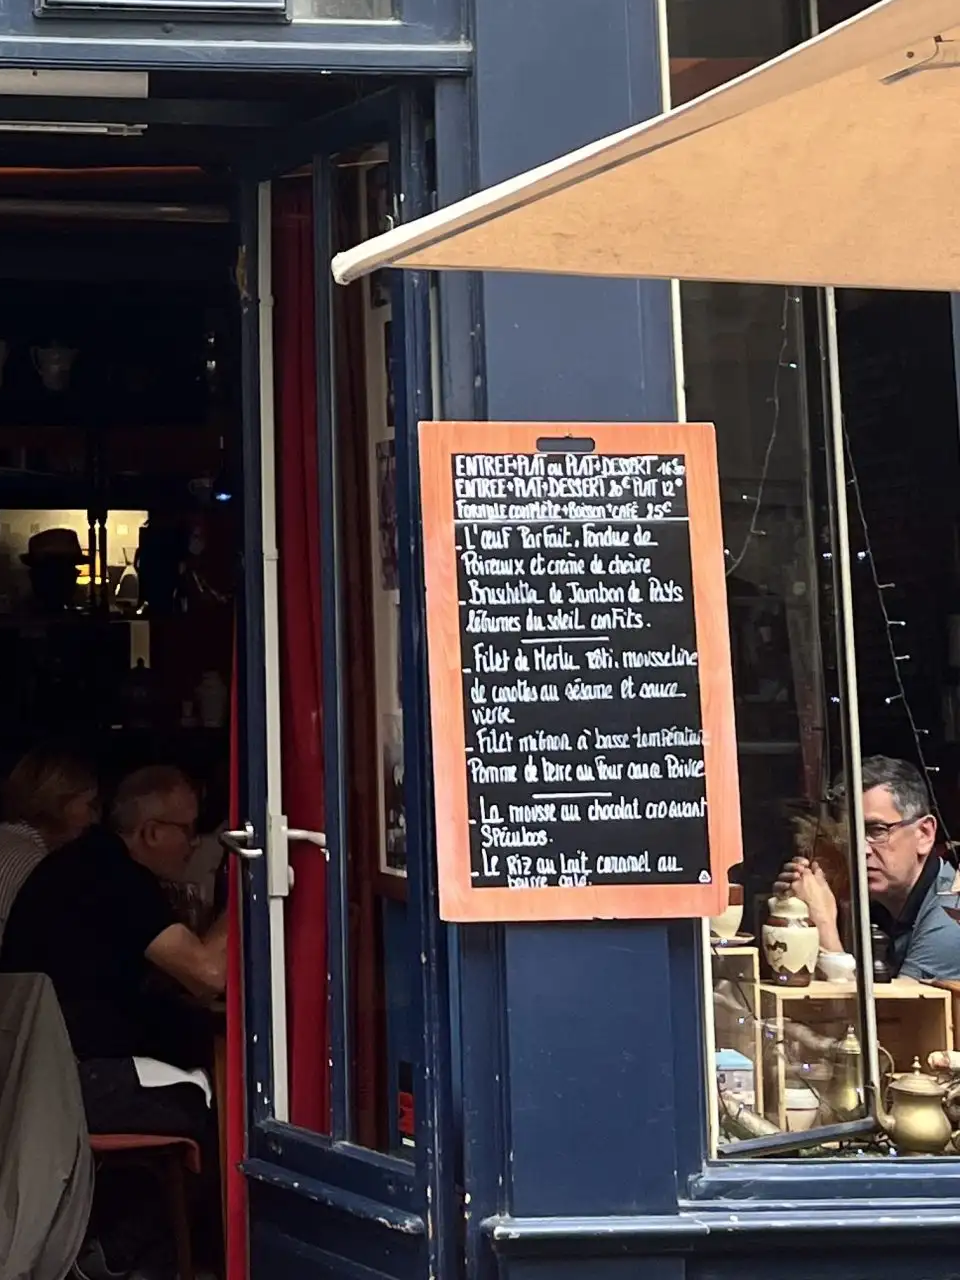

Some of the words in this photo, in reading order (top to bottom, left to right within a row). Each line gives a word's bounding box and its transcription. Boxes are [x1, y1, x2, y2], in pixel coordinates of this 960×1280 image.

[632, 476, 658, 497] PLAT
[633, 524, 658, 546] de
[530, 553, 546, 575] et
[590, 554, 606, 574] de
[549, 582, 564, 604] de
[566, 581, 625, 603] Jambon
[628, 580, 643, 602] de
[526, 607, 545, 631] du
[473, 642, 510, 673] Filet
[515, 648, 530, 672] de
[622, 644, 699, 669] mousseline
[471, 677, 487, 704] de
[540, 684, 560, 702] au
[620, 676, 637, 699] et
[639, 682, 687, 699] sauce
[476, 727, 513, 753] Filet
[577, 729, 592, 750] à
[594, 727, 631, 749] basse
[467, 757, 518, 783] Pomme
[524, 754, 540, 783] de
[576, 764, 596, 782] au
[480, 795, 505, 824] La
[509, 803, 558, 823] mousse
[561, 804, 582, 821] au
[588, 795, 642, 821] chocolat
[482, 848, 501, 877] Le
[536, 857, 558, 875] au
[596, 850, 652, 874] caramel
[657, 855, 684, 873] au
